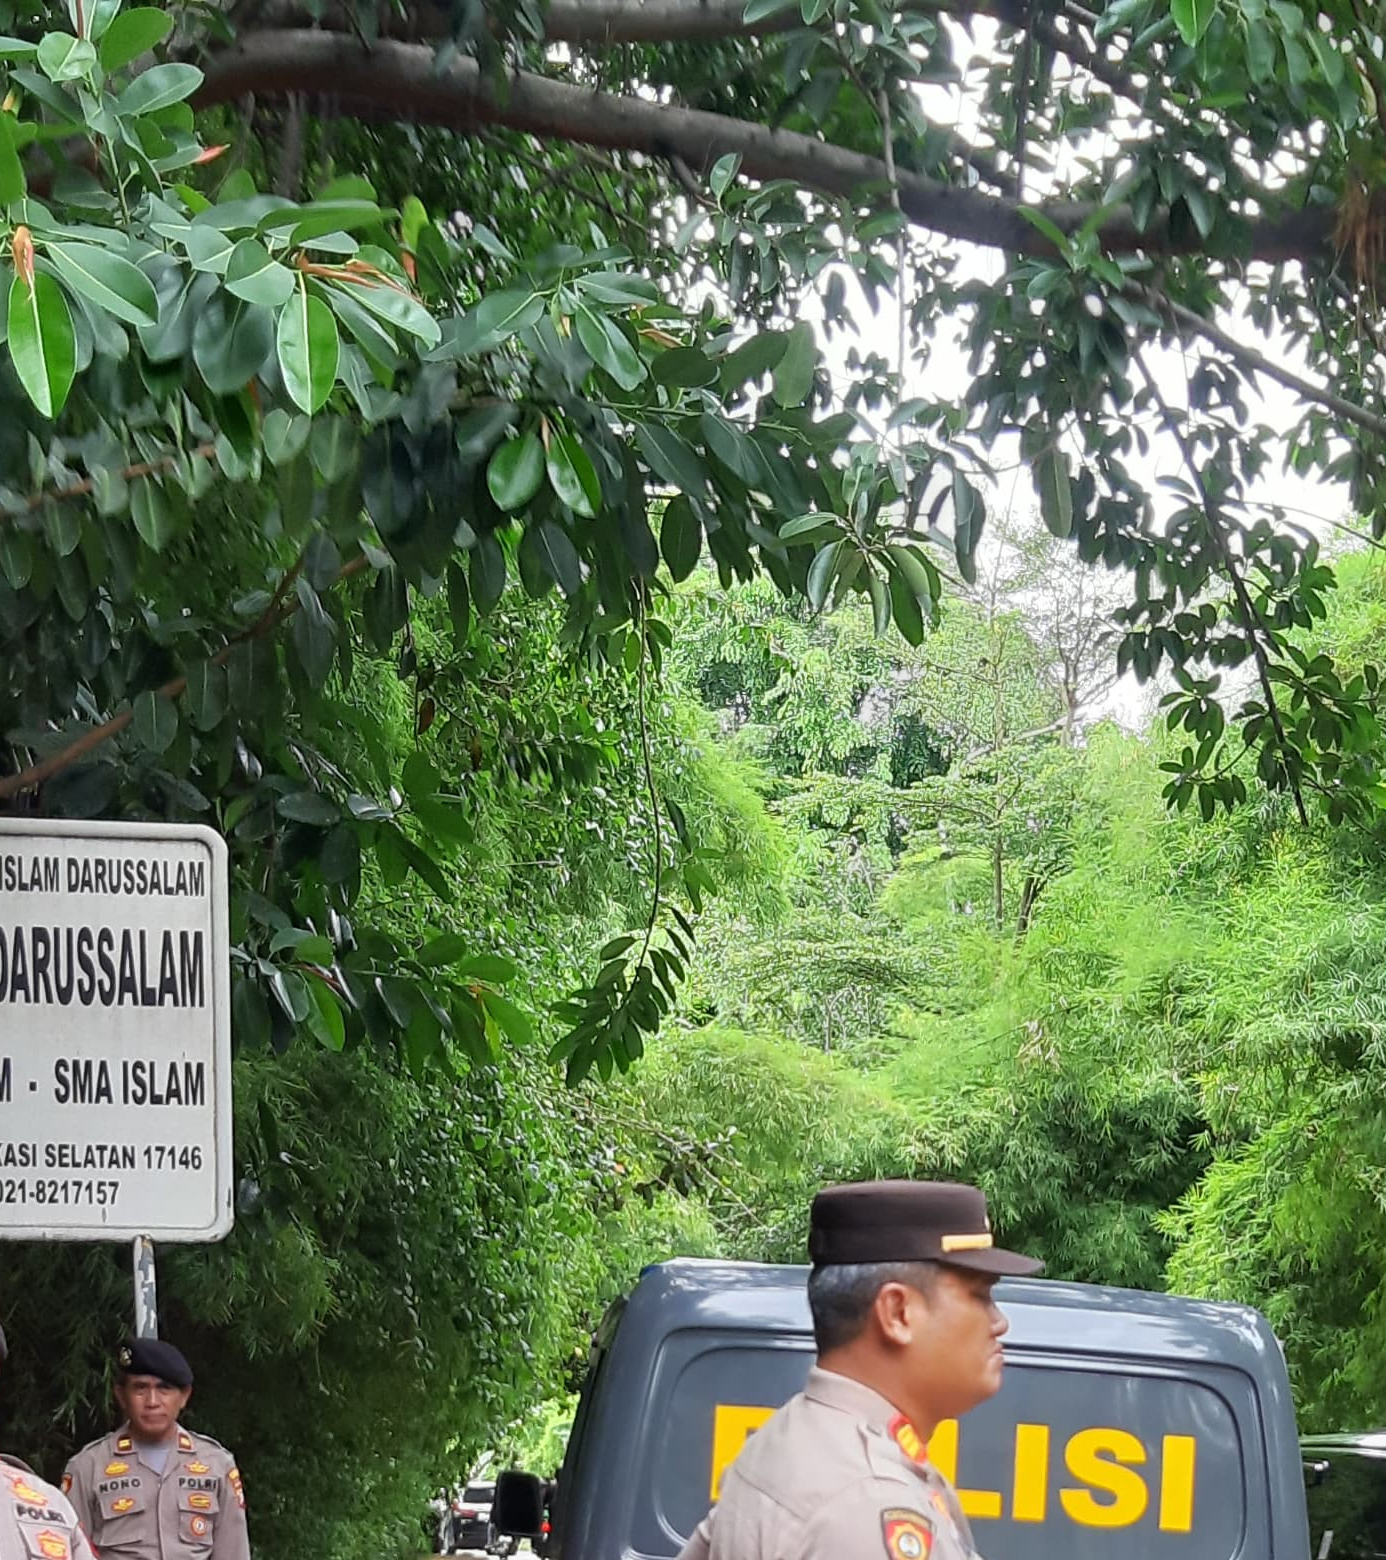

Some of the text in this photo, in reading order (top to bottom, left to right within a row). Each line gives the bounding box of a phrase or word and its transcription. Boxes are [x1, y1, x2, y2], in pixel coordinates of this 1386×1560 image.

[67, 857, 205, 896] DARUSSALAM
[54, 1058, 113, 1104] SMA
[122, 1060, 205, 1106] ISLAM
[44, 1143, 135, 1169] SELATAN
[143, 1146, 202, 1170] 17146
[178, 1477, 218, 1490] POLRI
[713, 1405, 1195, 1531] LISI
